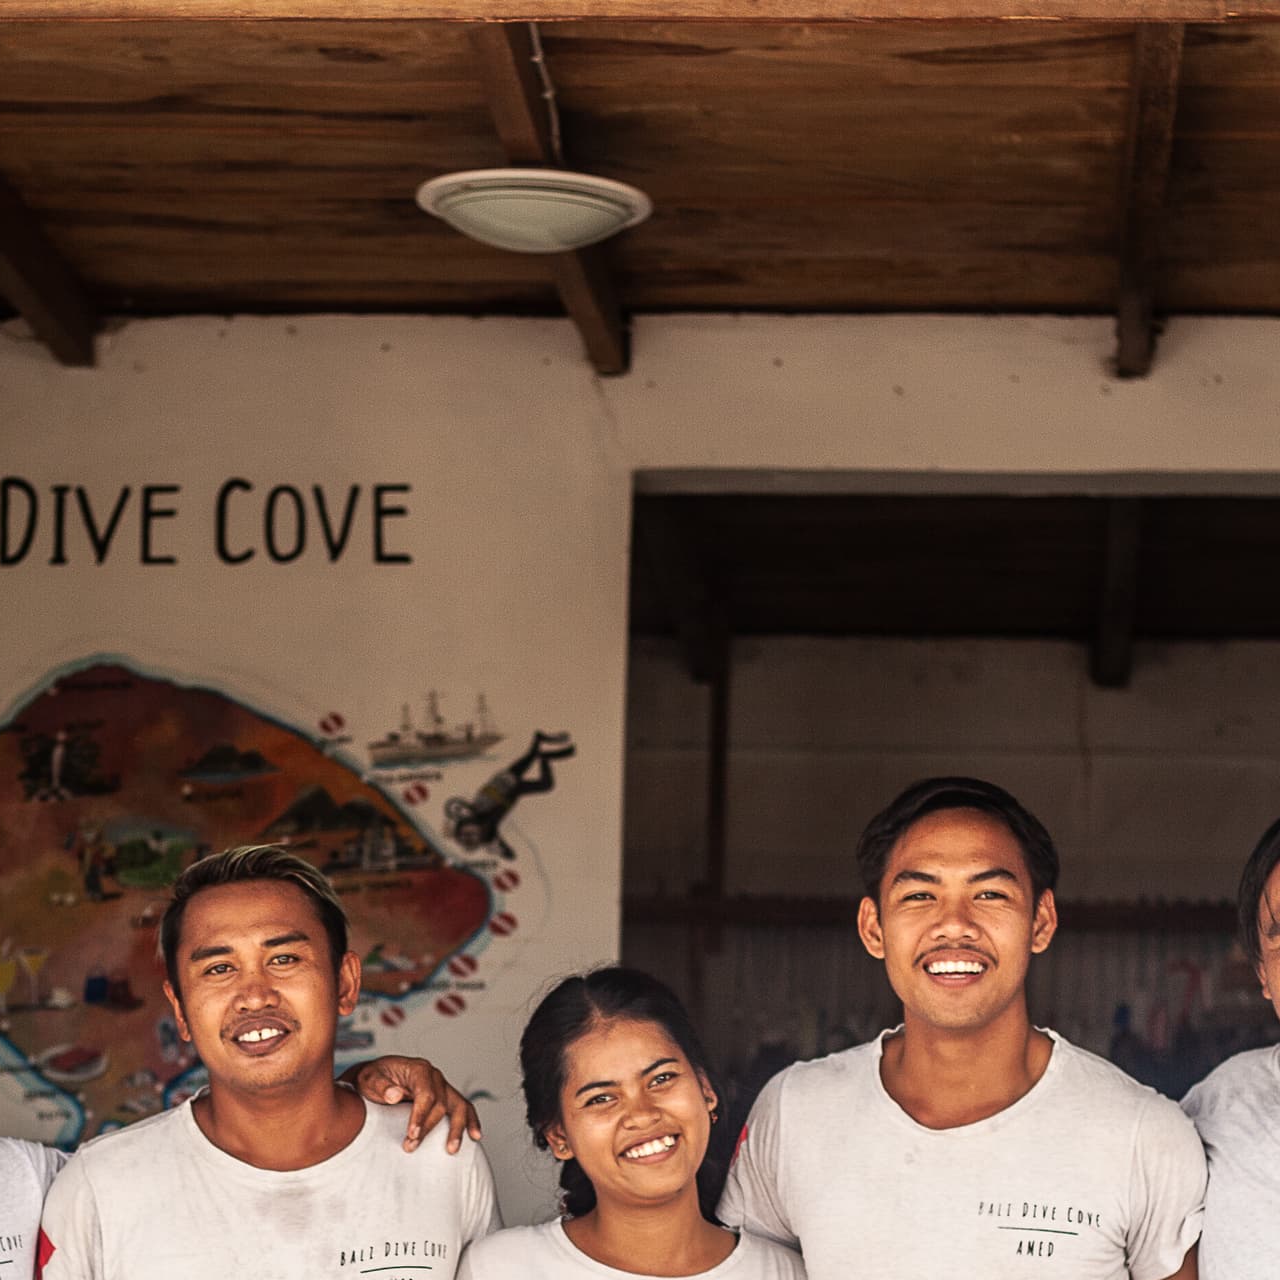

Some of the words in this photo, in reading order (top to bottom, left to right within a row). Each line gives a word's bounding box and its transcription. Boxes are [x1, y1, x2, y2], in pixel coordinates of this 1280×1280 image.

[213, 476, 414, 566] COVE
[1022, 1201, 1057, 1221] DIVE
[1067, 1206, 1101, 1228] COVE
[339, 1245, 374, 1267] BALI
[384, 1240, 416, 1257] DIVE
[1016, 1239, 1055, 1257] AMED
